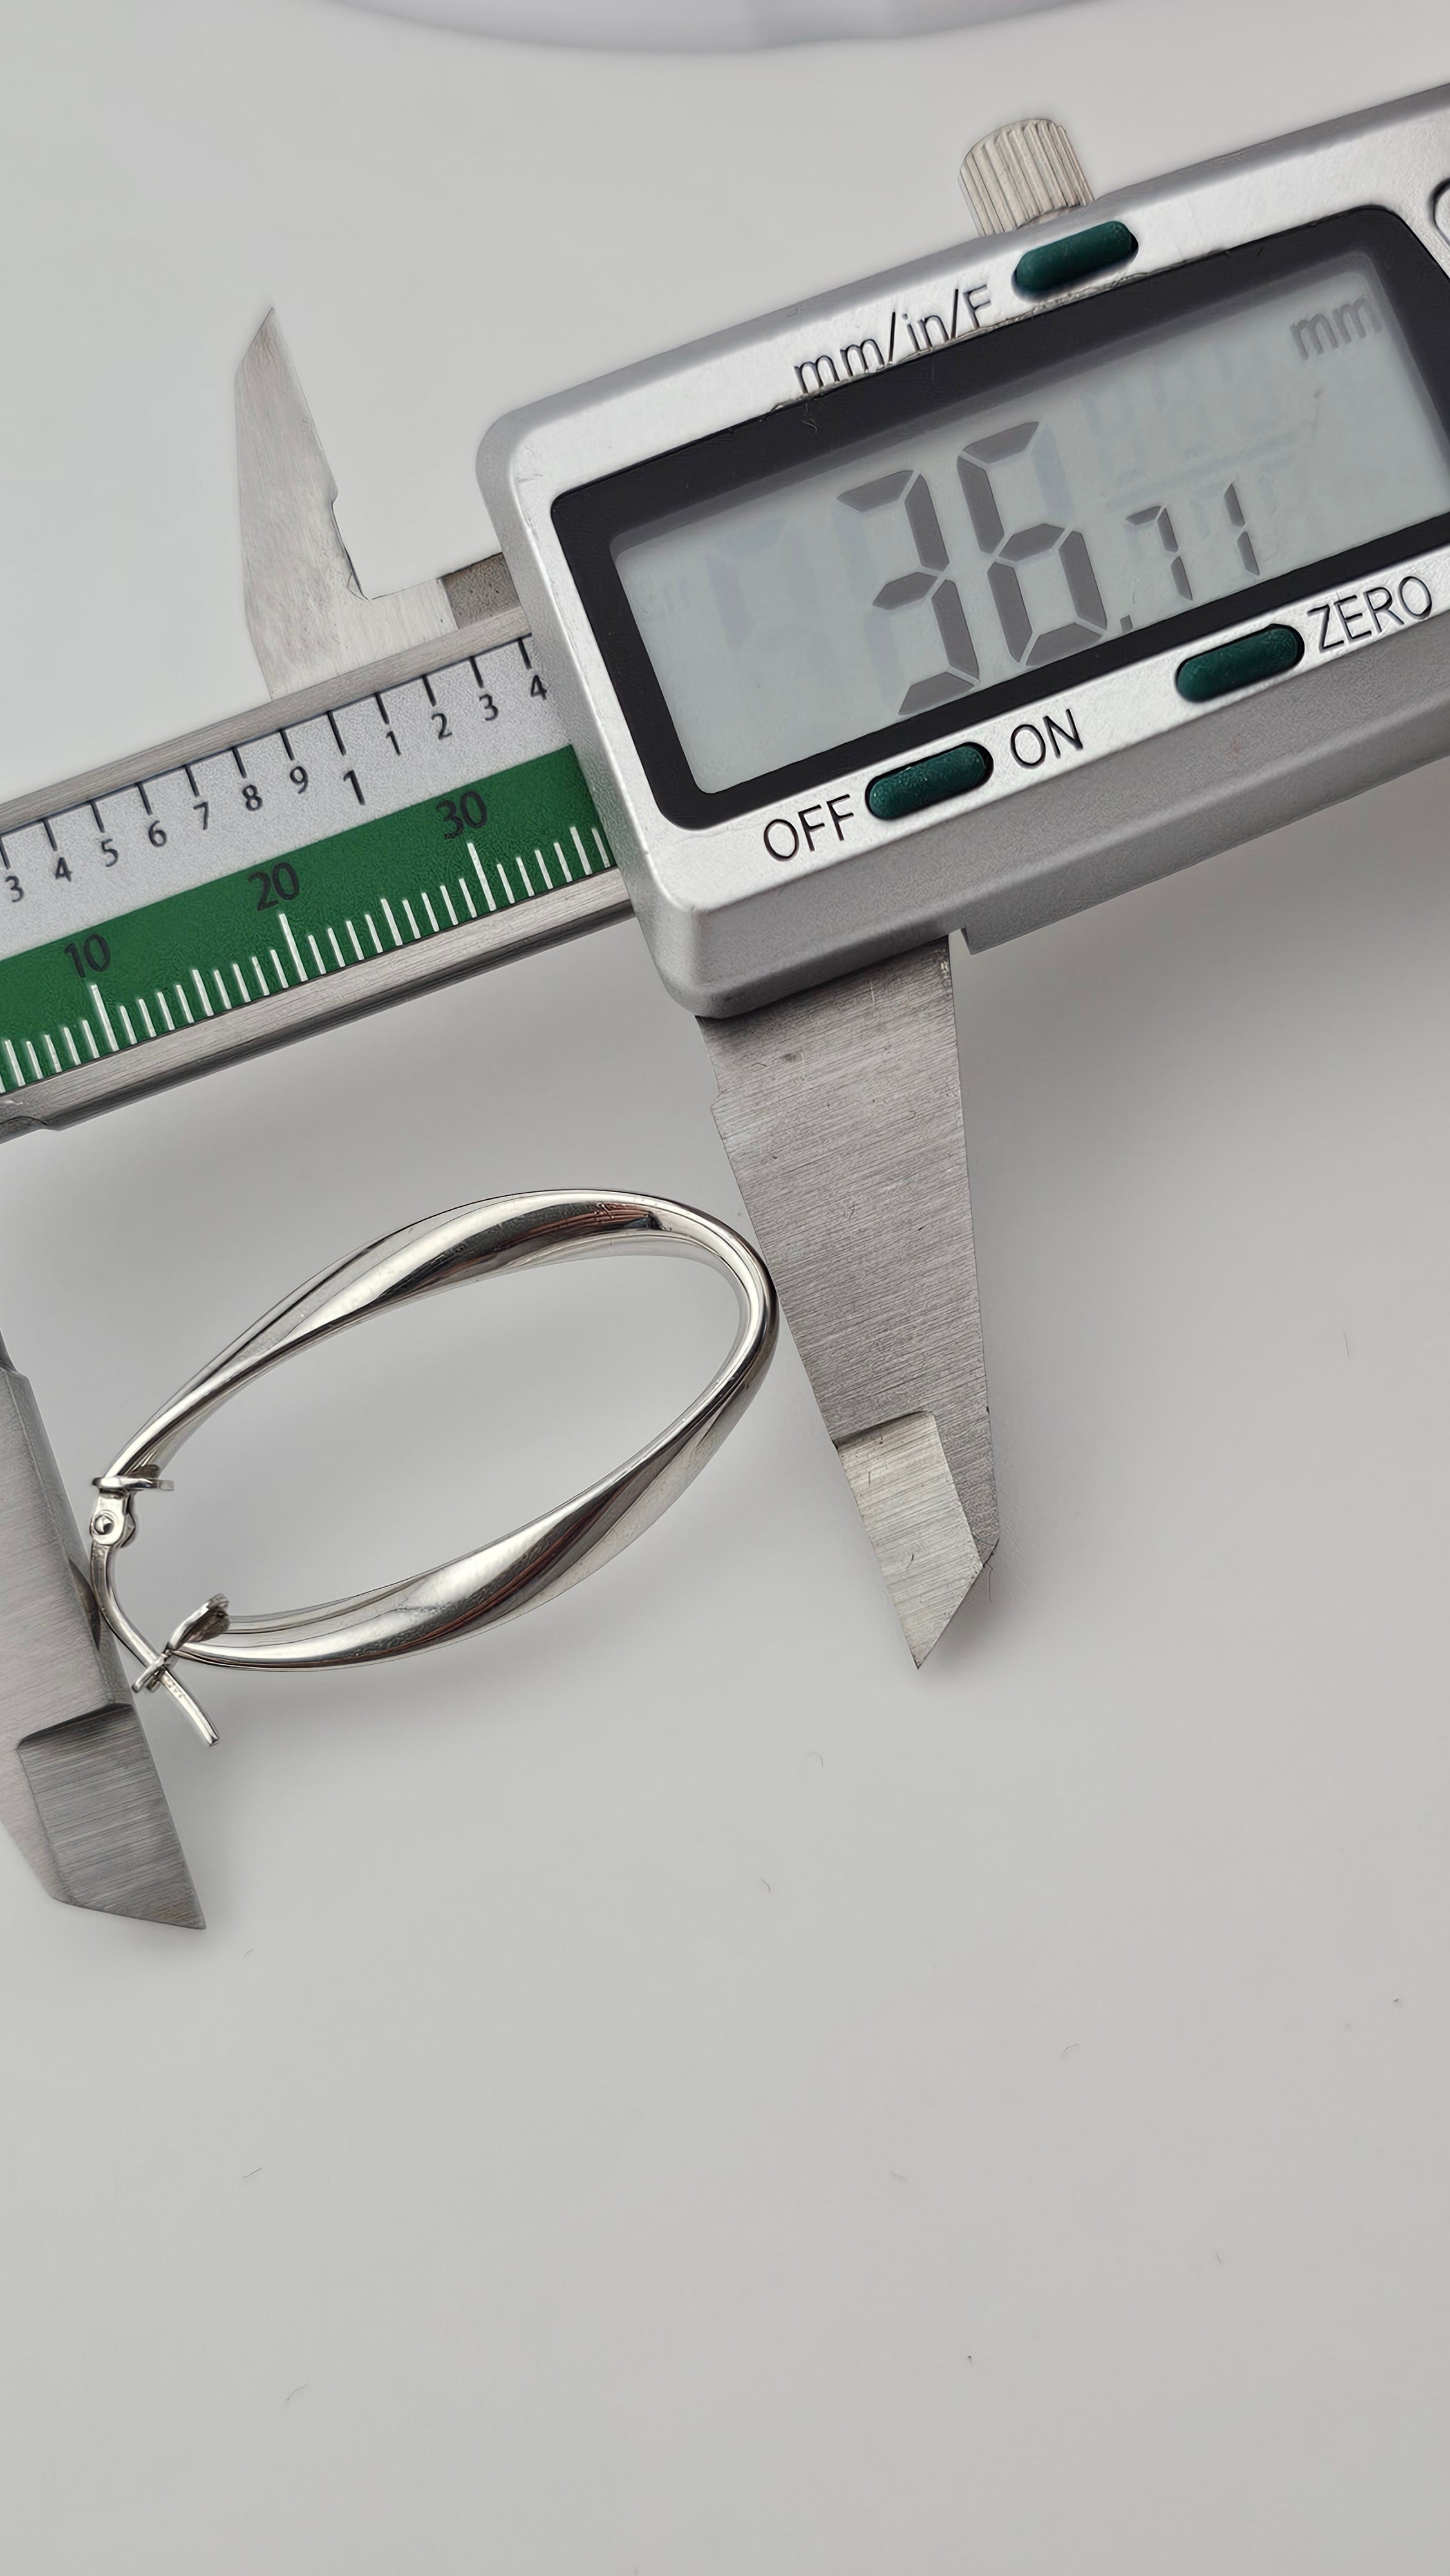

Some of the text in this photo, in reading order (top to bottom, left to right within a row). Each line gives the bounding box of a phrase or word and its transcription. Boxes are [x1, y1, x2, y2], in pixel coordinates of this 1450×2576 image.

[795, 283, 992, 395] mm/in/F
[1290, 294, 1383, 361] mm
[836, 422, 1260, 715] 36.71
[1306, 576, 1433, 653] ZERO
[5, 675, 548, 903] 3 4 5 6 7 8 9 1 1 2 3 4
[764, 709, 1084, 862] OFF ON
[64, 790, 487, 979] 10 20 30
